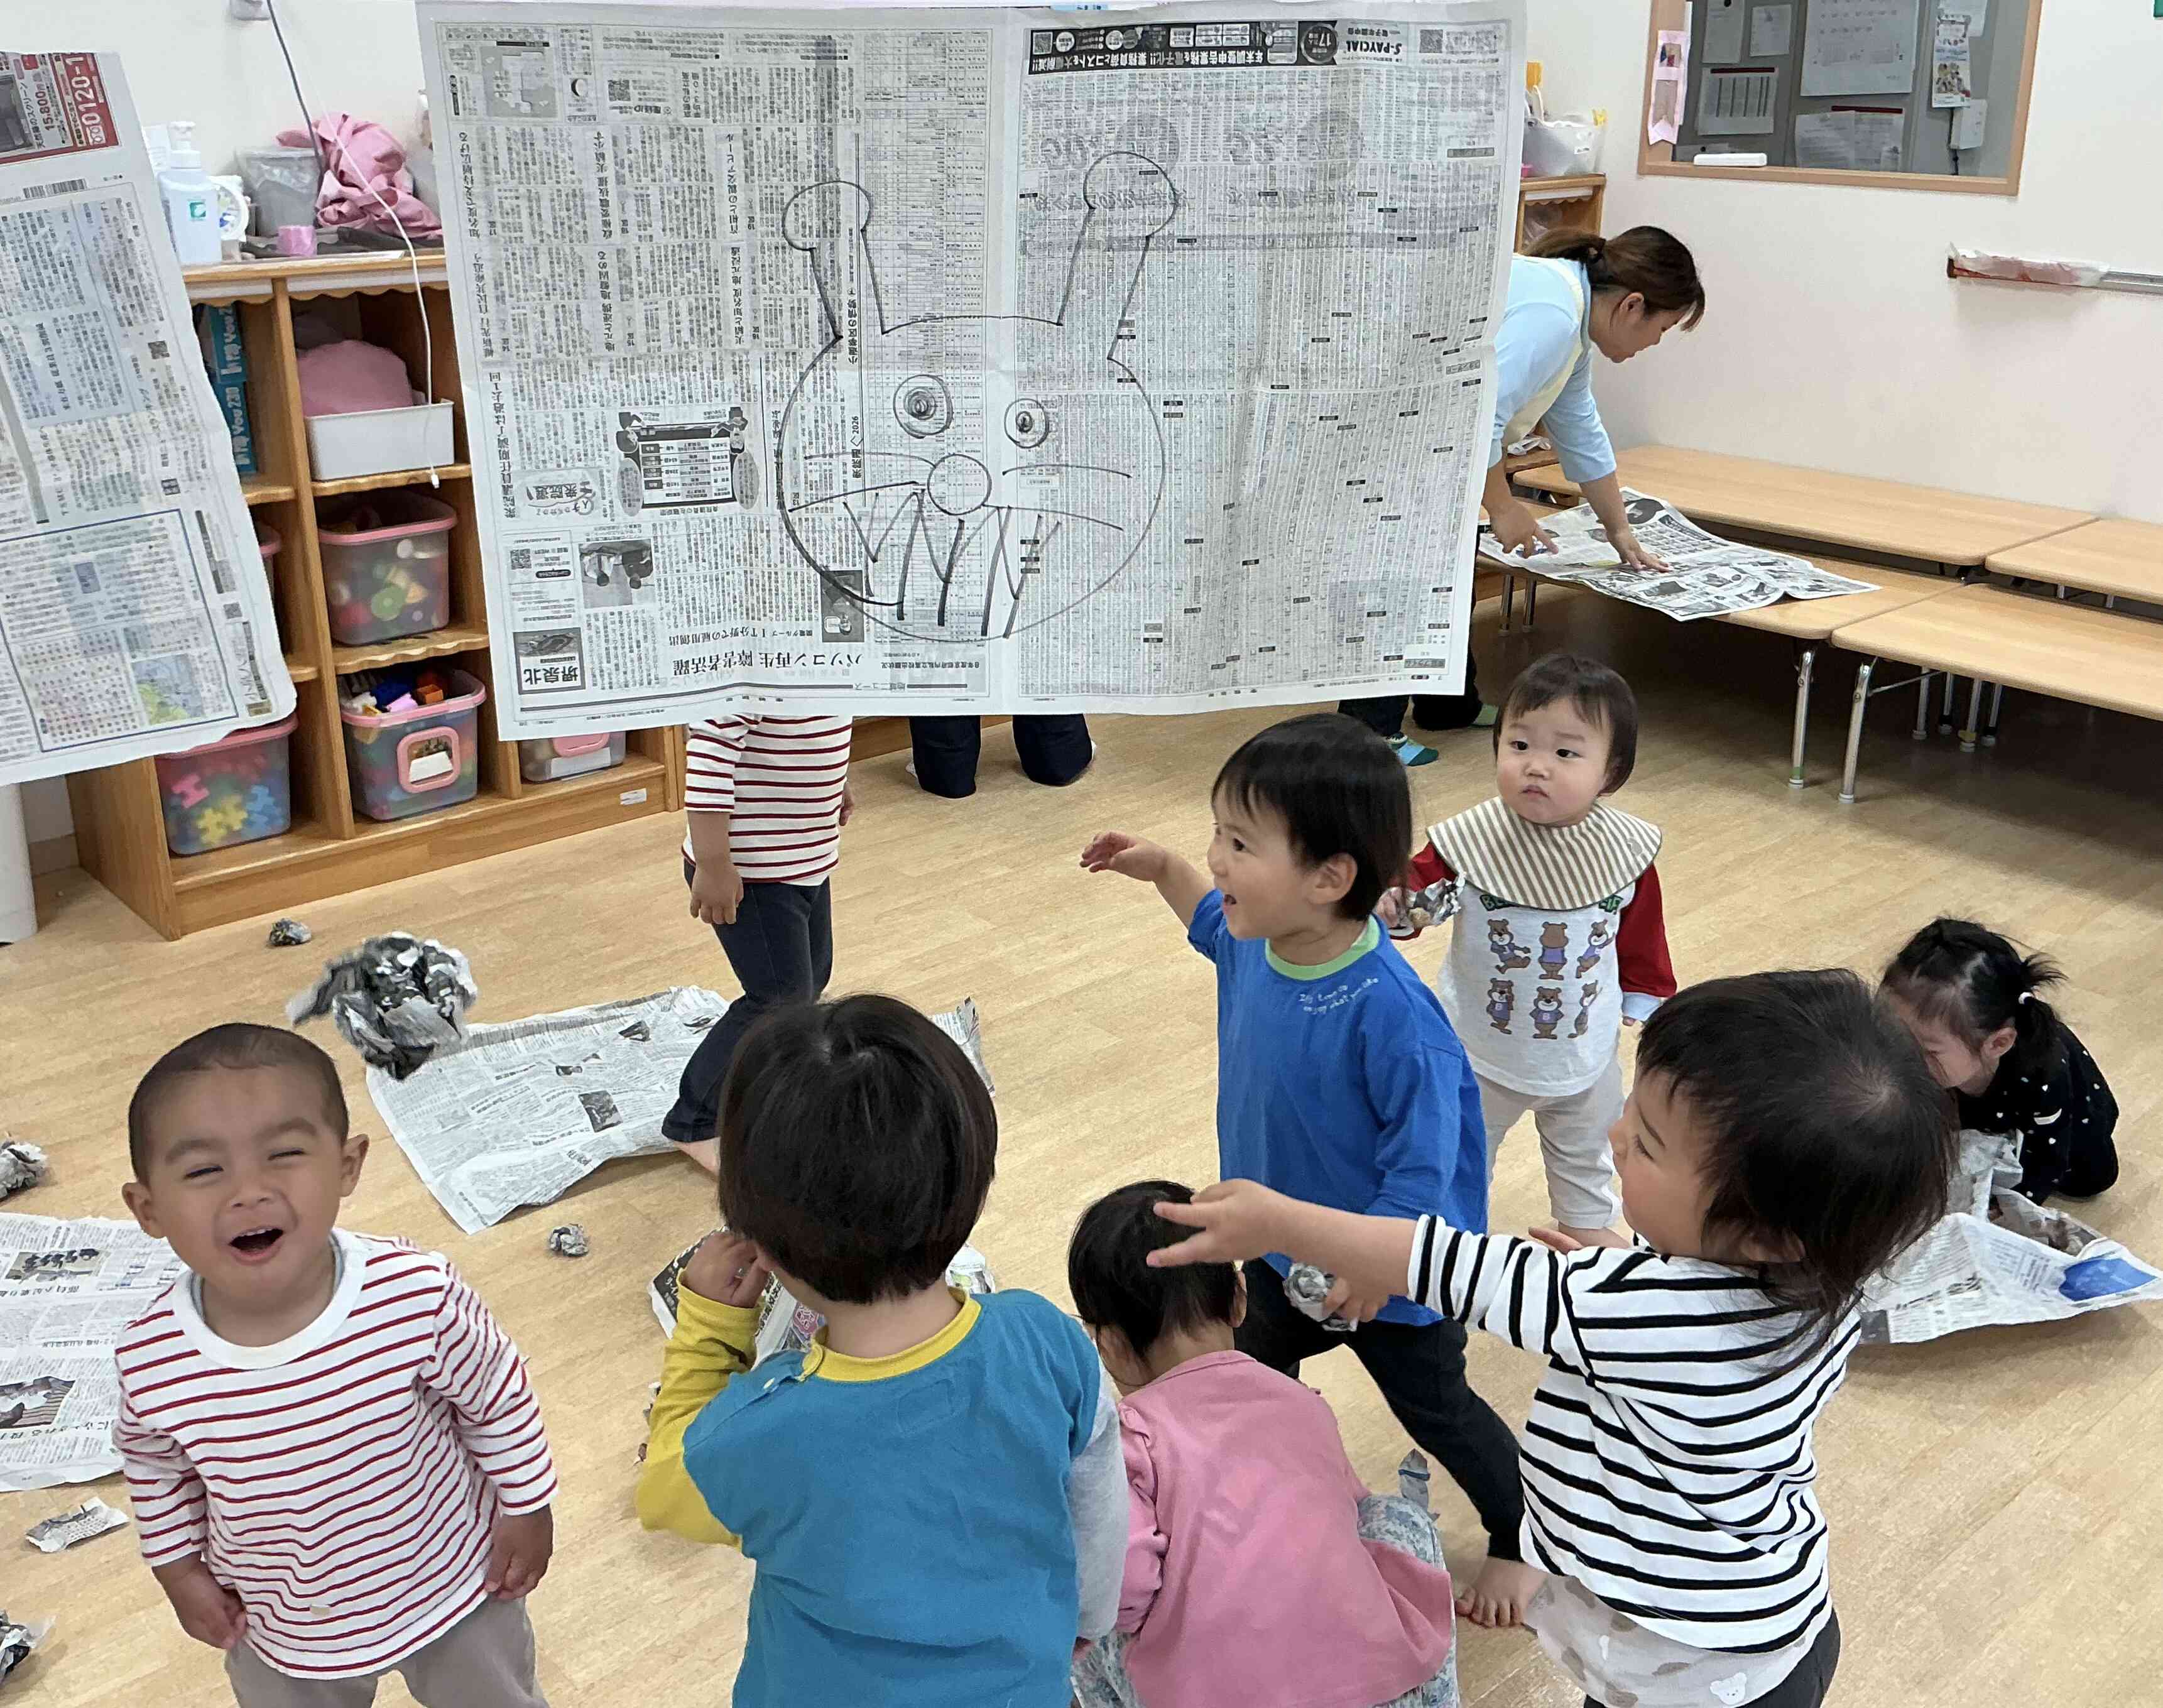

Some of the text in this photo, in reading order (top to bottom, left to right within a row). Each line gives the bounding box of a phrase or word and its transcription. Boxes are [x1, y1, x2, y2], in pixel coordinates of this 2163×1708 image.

[1319, 31, 1331, 46] 17
[1346, 39, 1402, 54] S-PAYCIAL
[847, 300, 858, 364] 小選挙区の情勢
[489, 371, 516, 518] 衆院議員任期満了は過去1回
[851, 415, 863, 479] 衆院選 2026
[523, 666, 579, 685] 堺泉北
[672, 648, 864, 676] パソコン再生 障害者活躍
